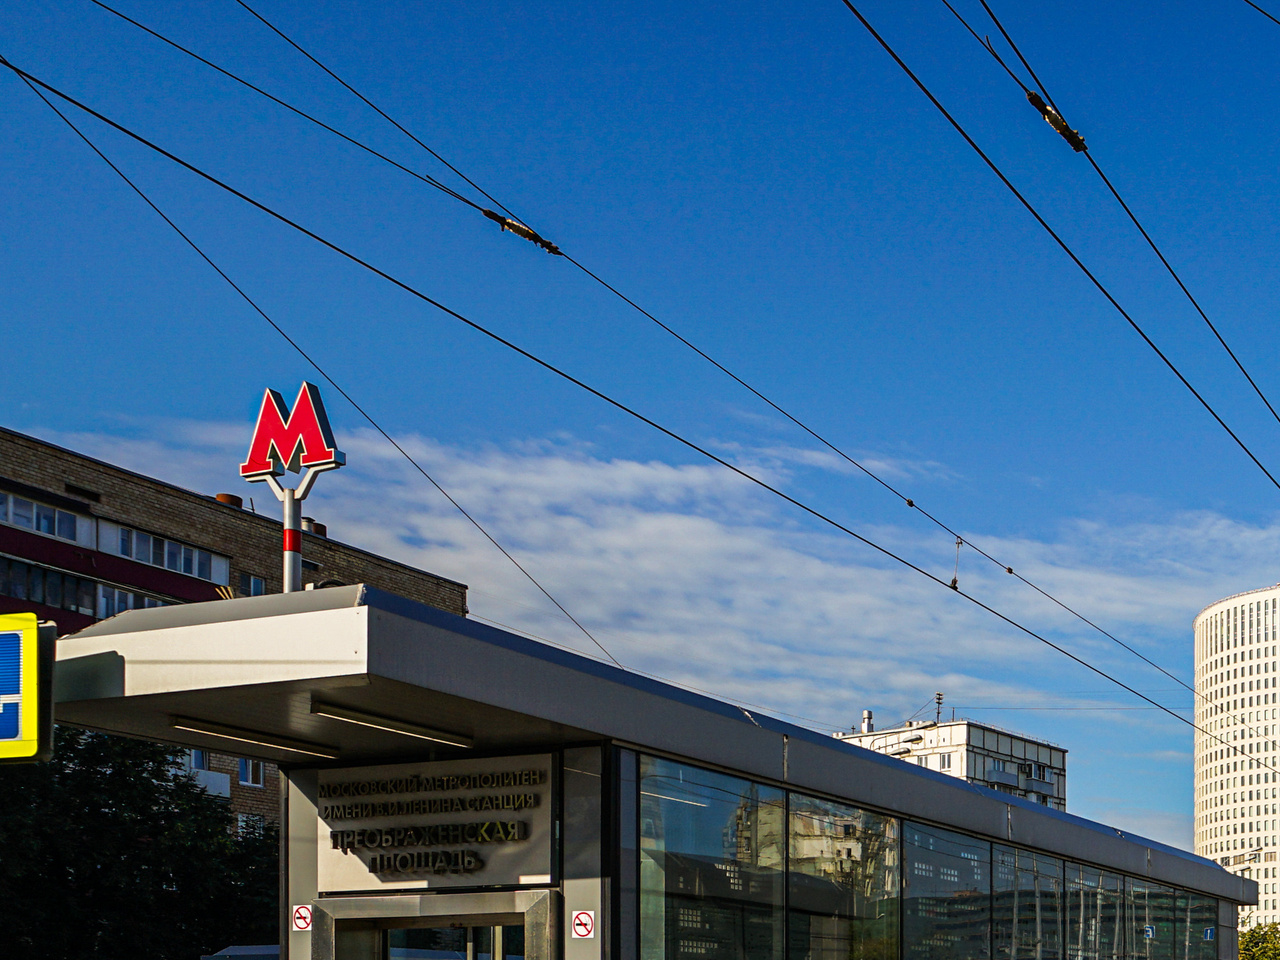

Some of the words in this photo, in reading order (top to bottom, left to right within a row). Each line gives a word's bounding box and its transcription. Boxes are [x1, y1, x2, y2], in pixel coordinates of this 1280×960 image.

[240, 380, 346, 477] М
[318, 775, 420, 798] МОСКОВСКИЙ
[422, 770, 541, 792] МЕТРОПОЛИТЕН
[323, 803, 374, 820] ИМЕНИ
[466, 793, 536, 813] СТАНЦИЯ
[330, 821, 520, 849] ПРЕОБРАЖЕНСКАЯ
[369, 850, 477, 874] ПЛОЩАДЬ
